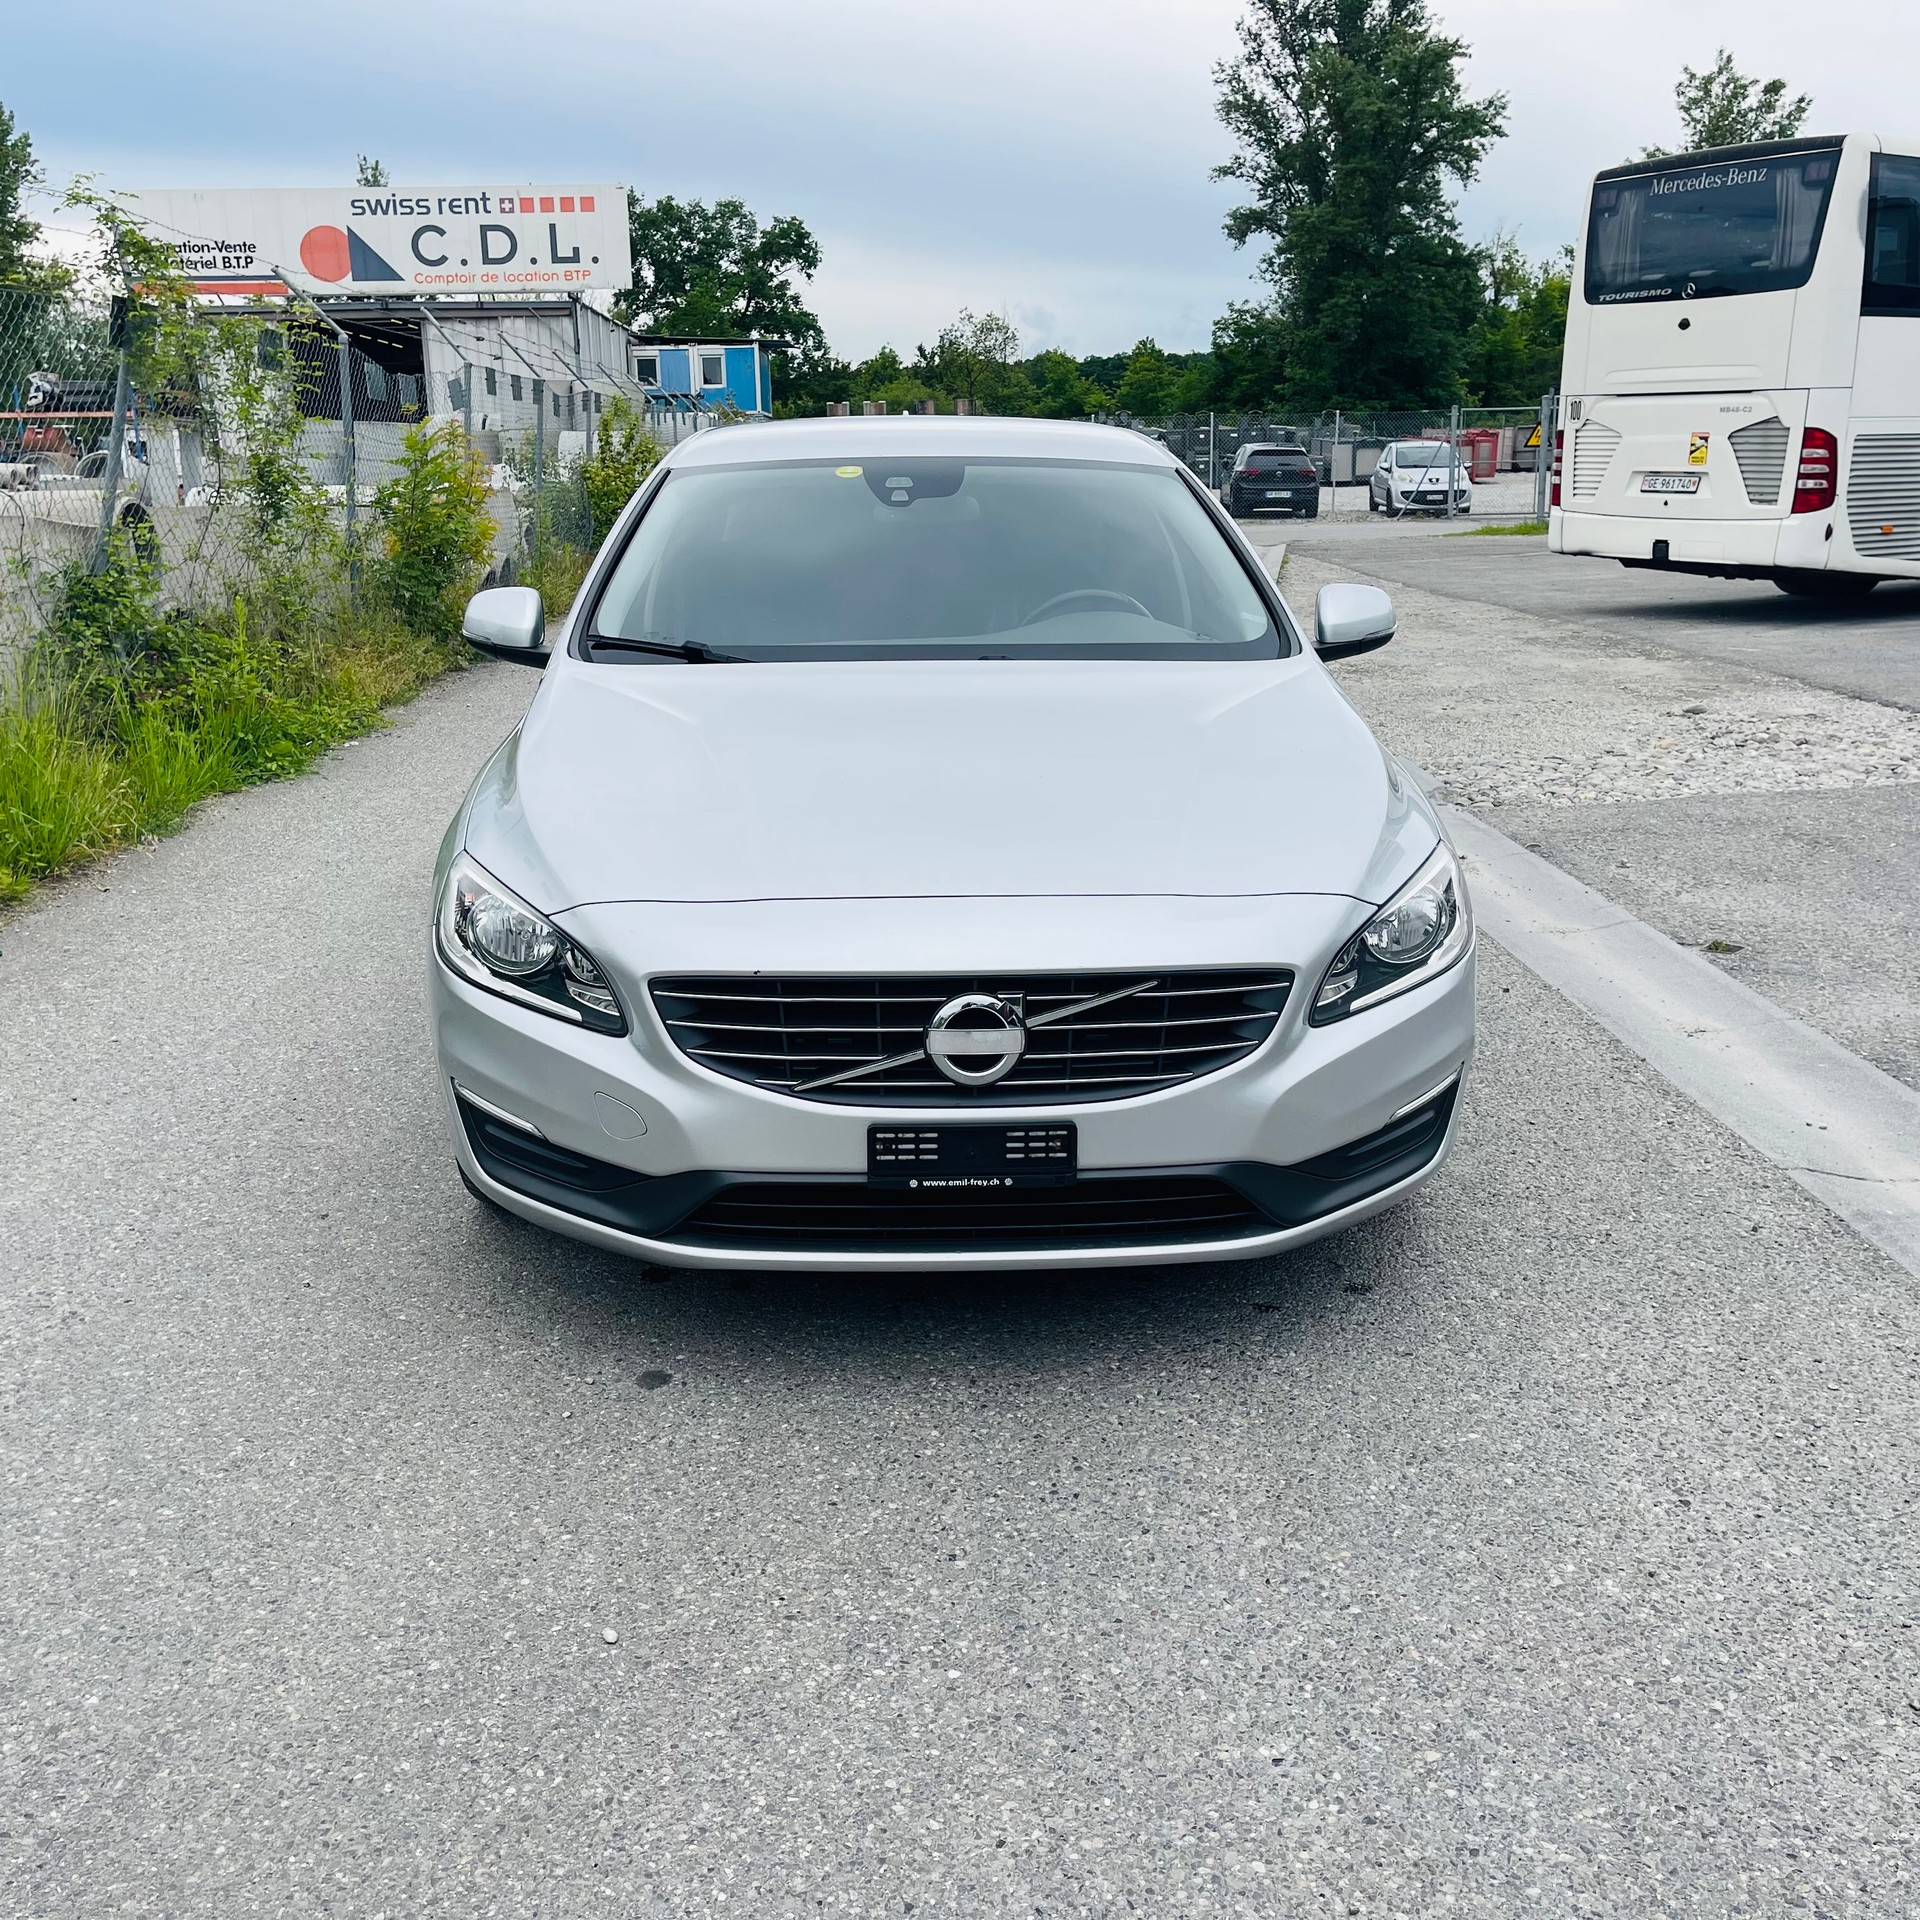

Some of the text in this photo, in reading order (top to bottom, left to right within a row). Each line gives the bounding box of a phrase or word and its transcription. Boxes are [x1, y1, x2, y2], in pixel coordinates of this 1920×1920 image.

[1649, 167, 1768, 196] Mercedes-Benz
[350, 191, 492, 216] swiss rent
[221, 255, 254, 269] B.T.P
[414, 270, 591, 286] Comptoir de location BTP
[1598, 287, 1673, 302] TOURISMO
[1570, 400, 1582, 420] 100
[923, 1178, 1000, 1187] www.emil-frey.ch
